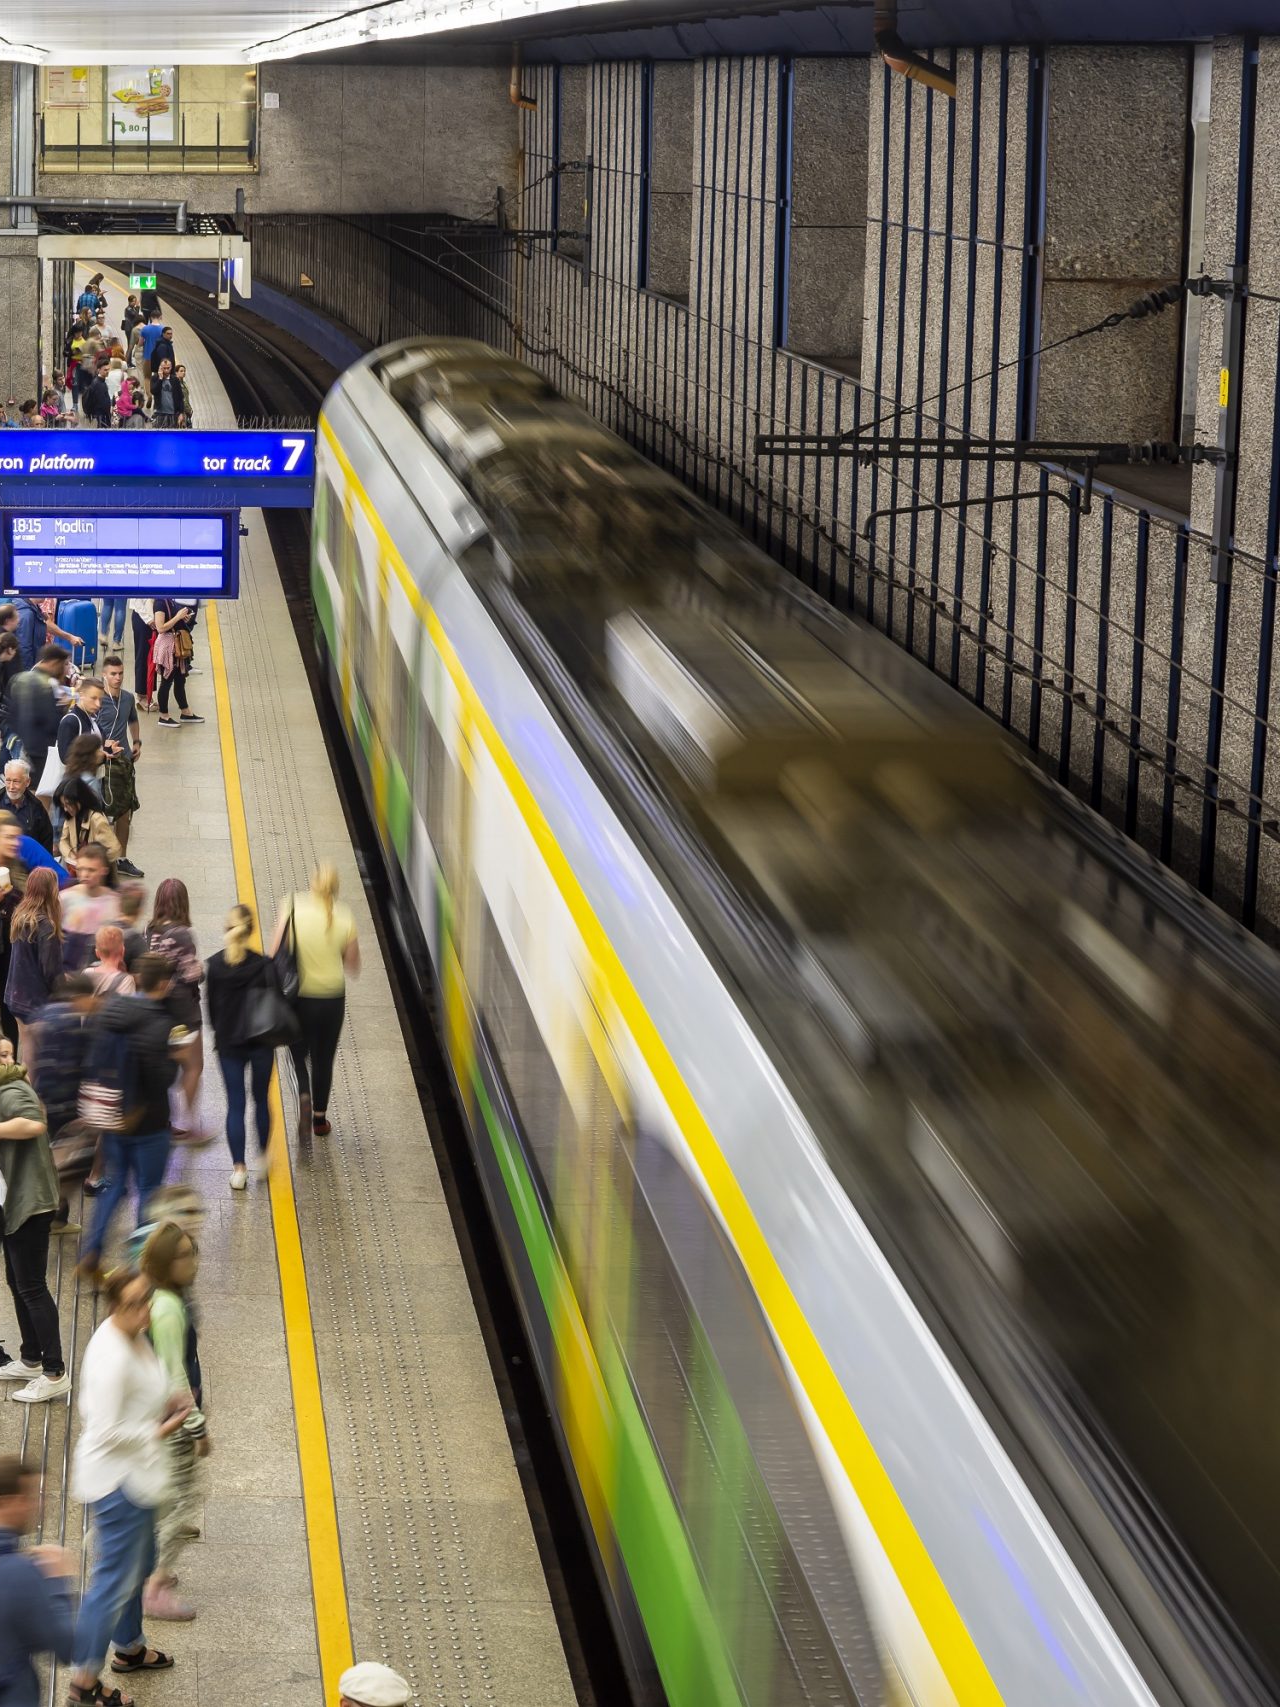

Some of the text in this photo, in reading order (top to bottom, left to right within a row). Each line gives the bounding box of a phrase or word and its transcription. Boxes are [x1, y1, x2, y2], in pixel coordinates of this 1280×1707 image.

[29, 454, 95, 473] platform
[203, 456, 226, 471] tor
[233, 455, 271, 471] track
[281, 438, 306, 471] 7
[13, 518, 94, 533] 18:15 Modlin
[54, 535, 66, 546] KM
